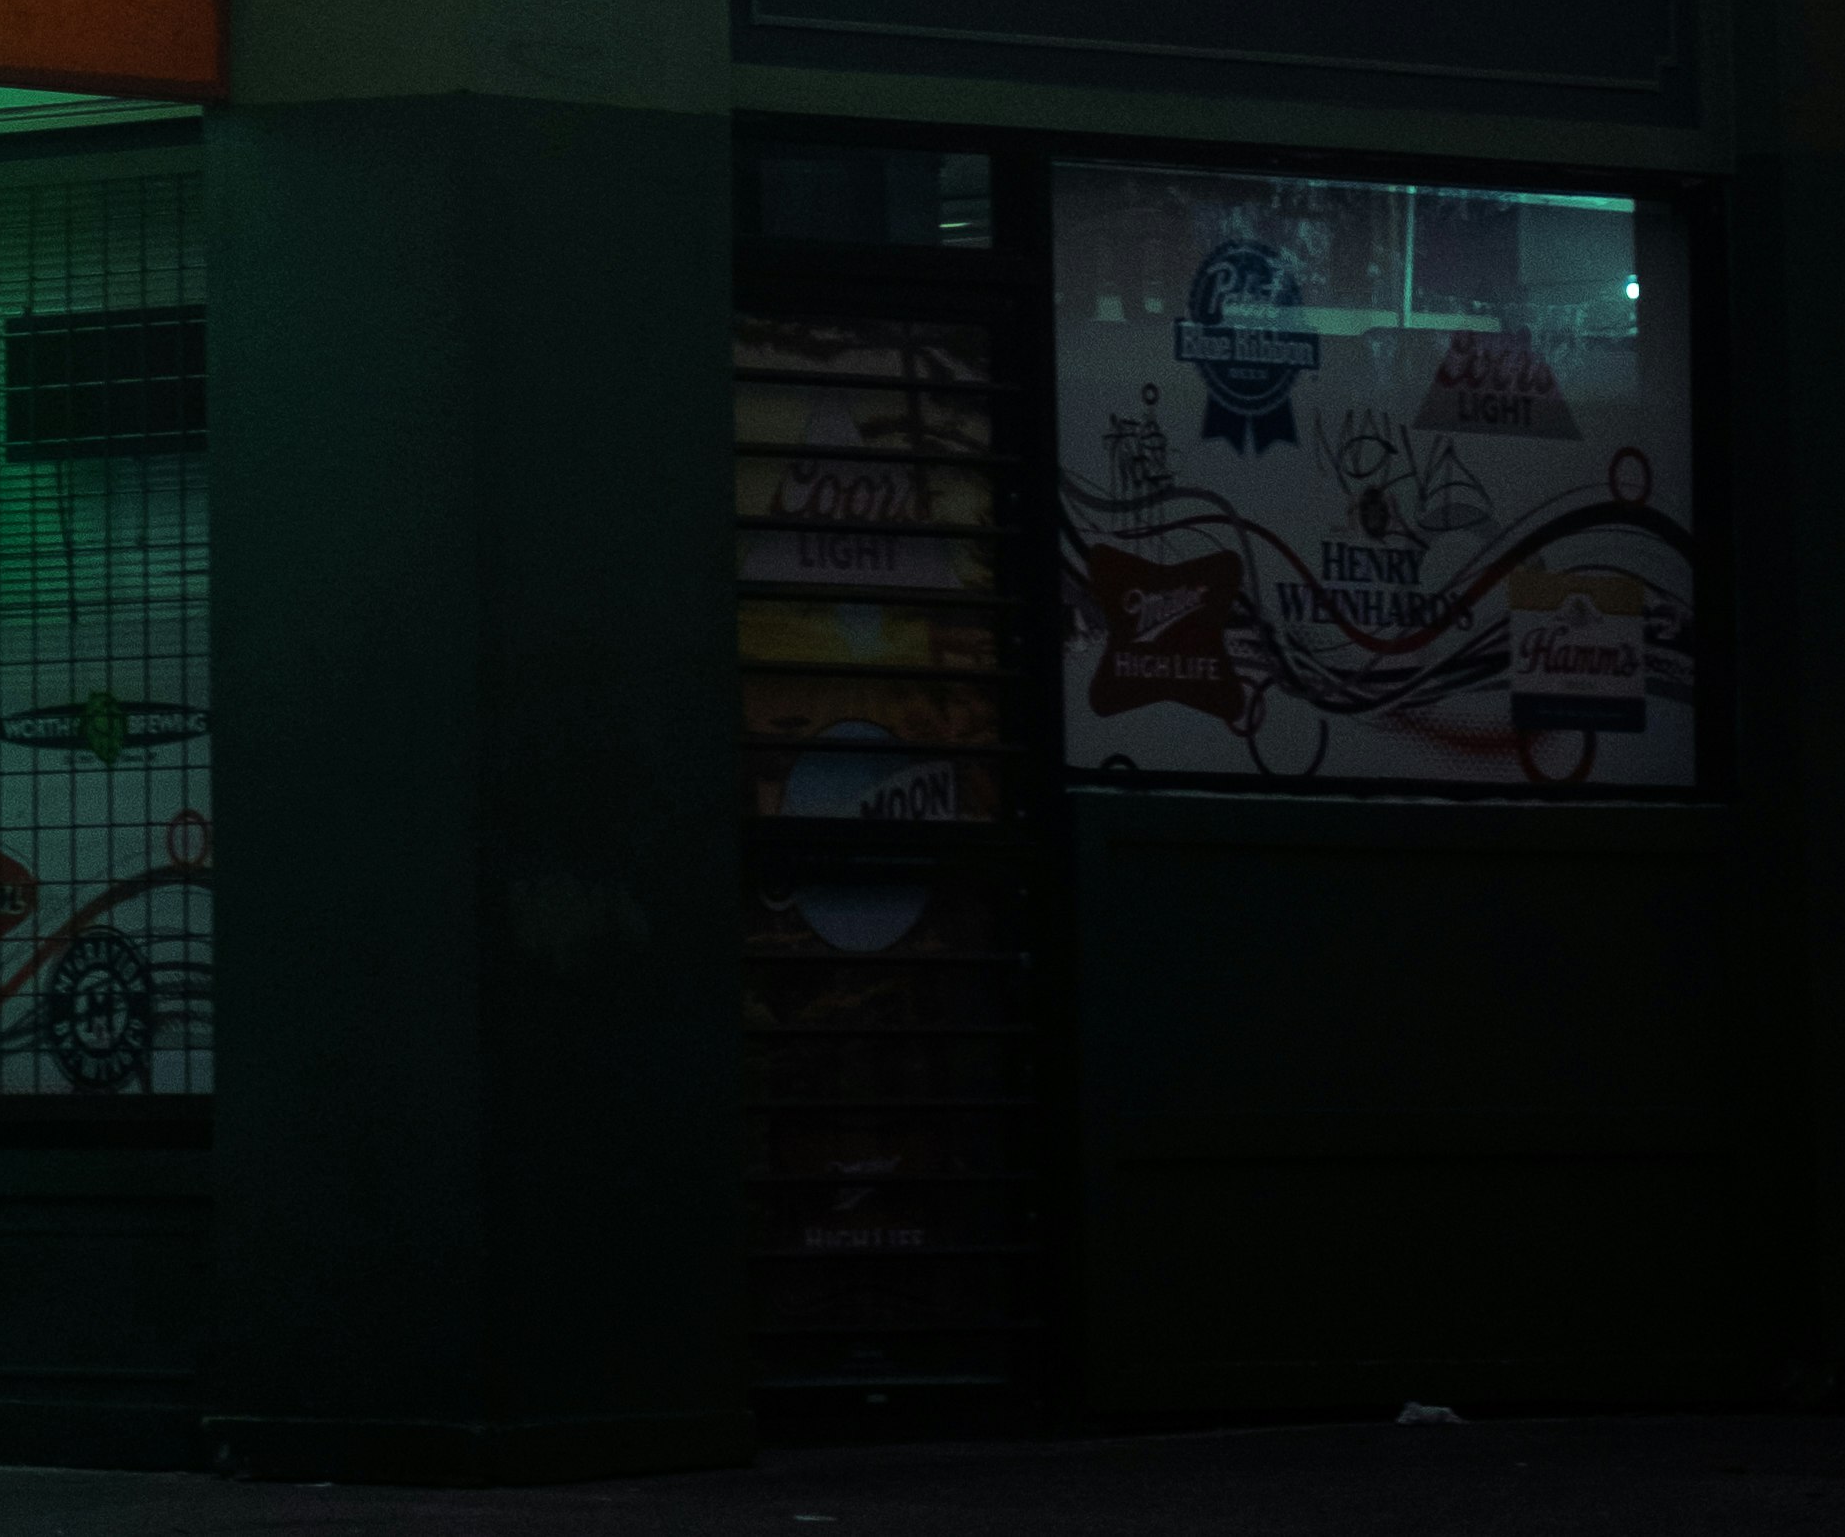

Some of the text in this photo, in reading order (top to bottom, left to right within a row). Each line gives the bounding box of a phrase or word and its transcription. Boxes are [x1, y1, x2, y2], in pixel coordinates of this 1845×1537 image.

[1458, 391, 1533, 427] LIGHT
[798, 531, 900, 572] LIGHT
[1321, 540, 1426, 586] HENRY
[1114, 652, 1222, 681] HIGH LIFE
